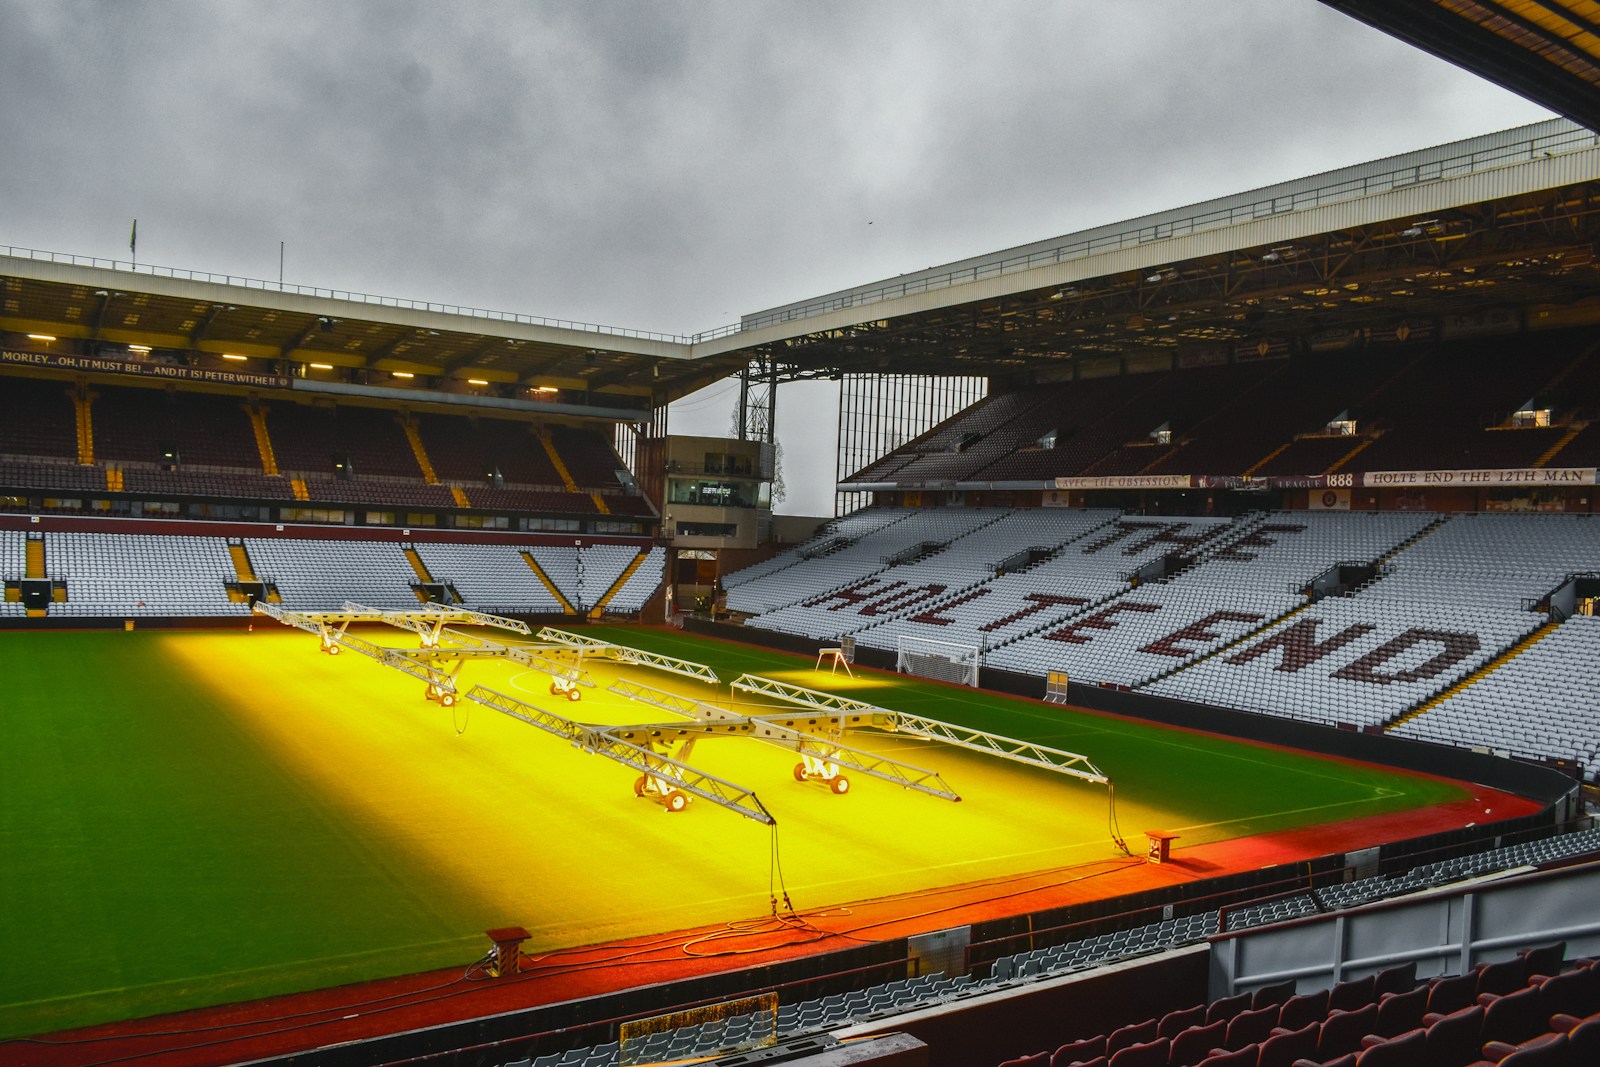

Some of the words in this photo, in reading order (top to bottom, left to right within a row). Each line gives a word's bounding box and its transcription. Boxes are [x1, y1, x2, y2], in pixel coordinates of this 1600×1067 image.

[80, 359, 90, 368] IT
[92, 360, 121, 370] MUST
[125, 364, 140, 373] BE!
[178, 369, 187, 377] IT
[191, 370, 202, 378] IS!
[205, 371, 235, 381] PETER
[1062, 478, 1088, 487] AVFC
[1095, 477, 1116, 487] THE
[1119, 476, 1179, 486] OBSESSION
[1279, 480, 1321, 488] LEAGUE
[1326, 473, 1353, 487] 1888
[1373, 473, 1417, 484] HOLTE
[1424, 472, 1454, 483] END
[1460, 471, 1491, 482] THE
[1499, 470, 1536, 481] 12TH
[1543, 470, 1584, 481] MAN
[1081, 521, 1308, 562] THE
[802, 578, 1158, 644] HOLTE
[1138, 609, 1481, 685] END
